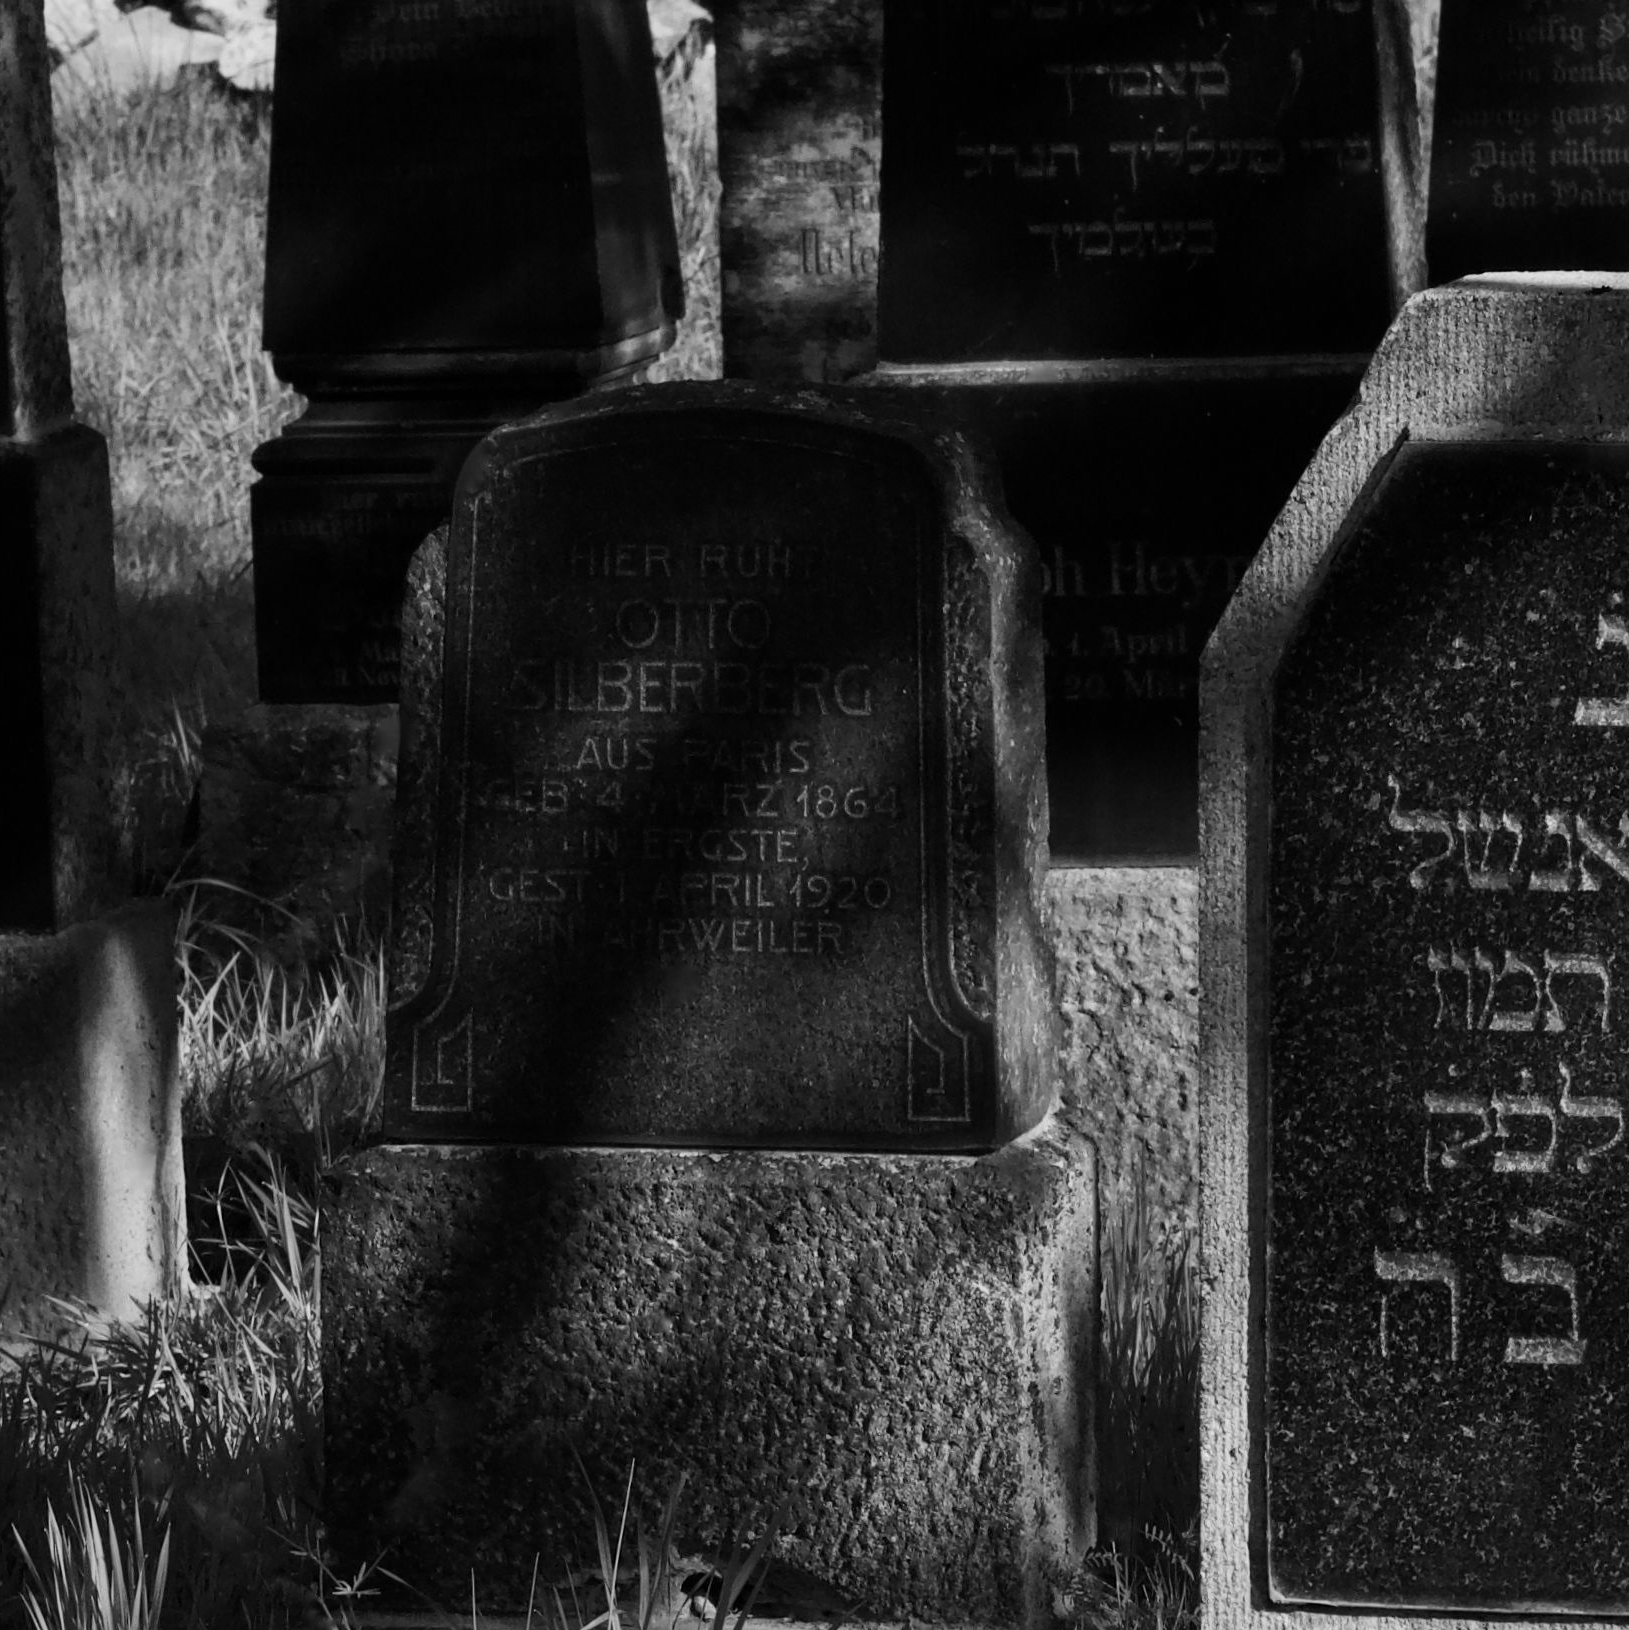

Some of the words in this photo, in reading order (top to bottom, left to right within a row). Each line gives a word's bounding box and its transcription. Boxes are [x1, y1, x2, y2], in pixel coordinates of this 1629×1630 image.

[569, 542, 672, 580] HIER
[614, 596, 773, 652] OTTO
[508, 656, 874, 718] SILBERBERG
[573, 735, 657, 773] AUS
[681, 737, 813, 775] PARIS
[651, 872, 775, 910] APRIL
[789, 875, 893, 911] 1920
[603, 916, 847, 957] AHRWEILER
